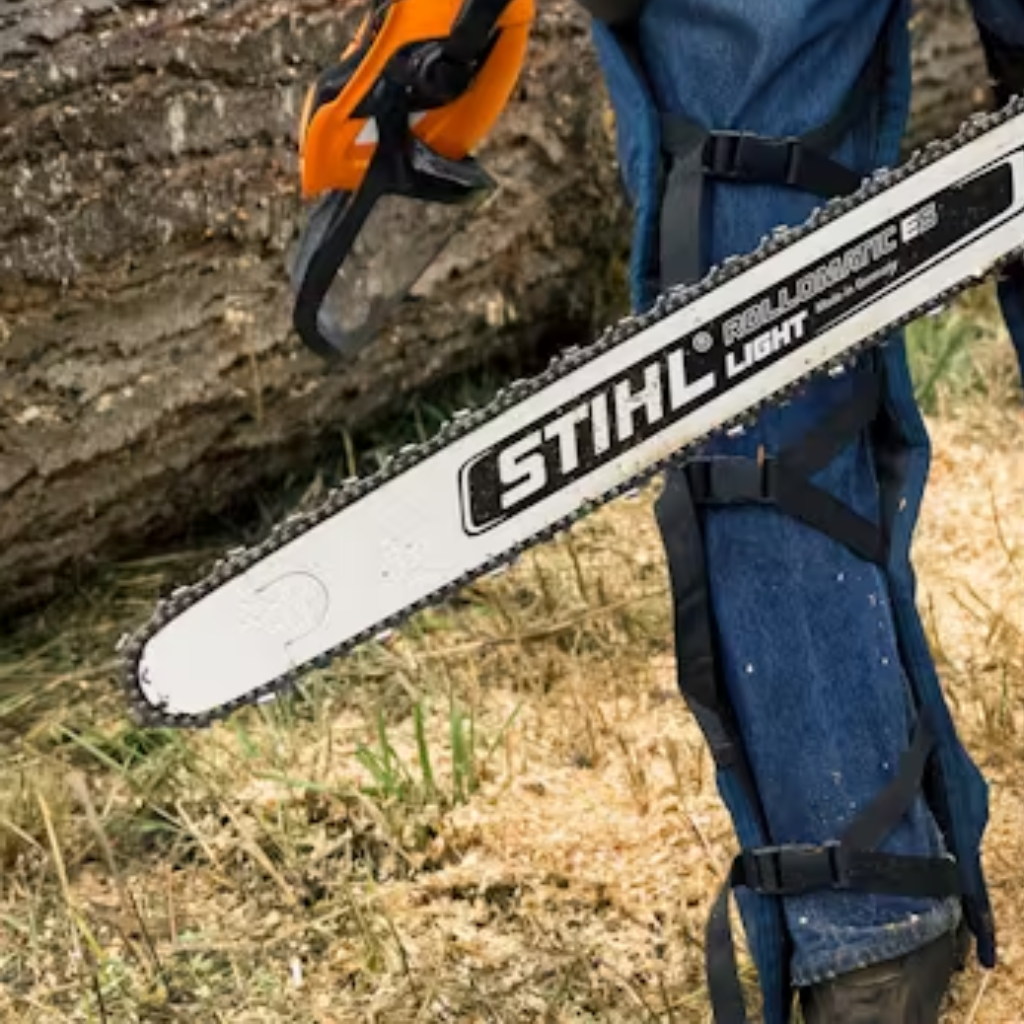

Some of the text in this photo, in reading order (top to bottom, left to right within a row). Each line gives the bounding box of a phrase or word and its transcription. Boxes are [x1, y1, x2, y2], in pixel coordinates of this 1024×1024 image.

[722, 225, 898, 346] ROLLOMATIC
[725, 310, 808, 378] LIGHT
[498, 348, 716, 510] STIHL
